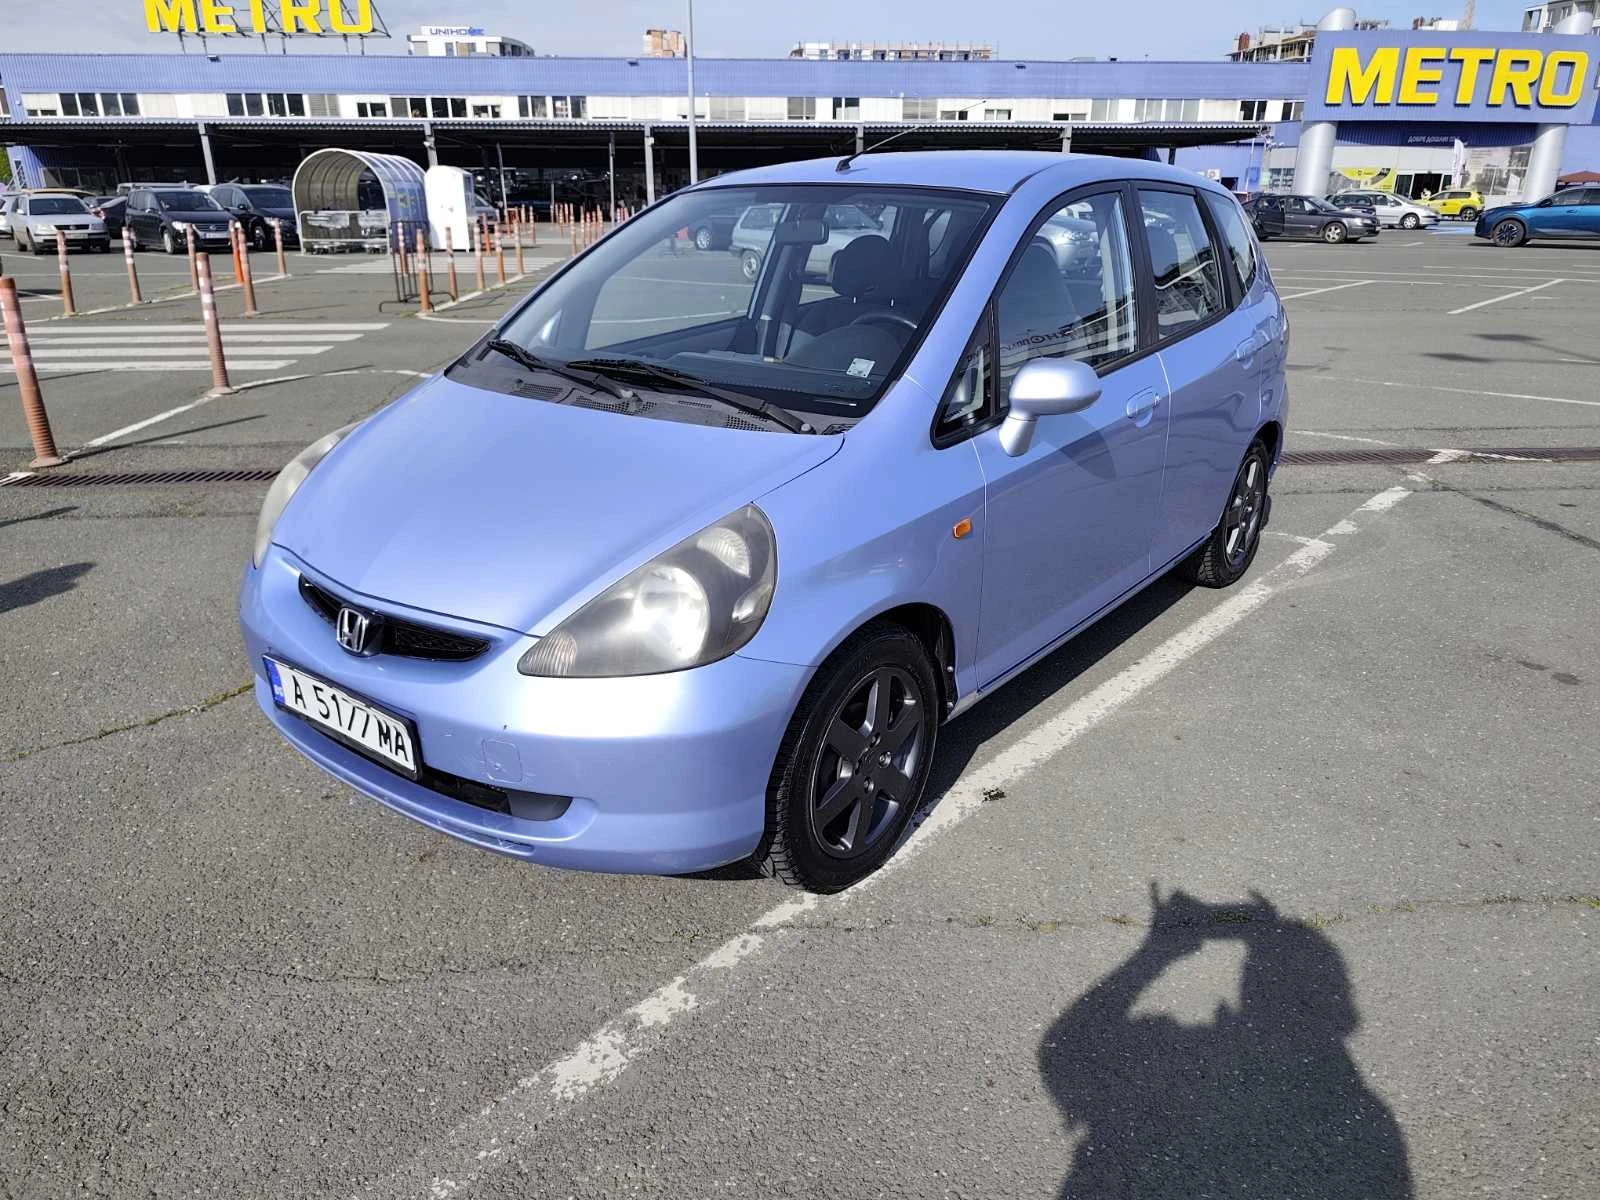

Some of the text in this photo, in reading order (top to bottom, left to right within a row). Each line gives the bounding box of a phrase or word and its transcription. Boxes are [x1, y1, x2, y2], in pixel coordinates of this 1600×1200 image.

[143, 0, 373, 33] METRO
[1325, 47, 1589, 107] METRO
[292, 675, 409, 762] A 5177 MA
